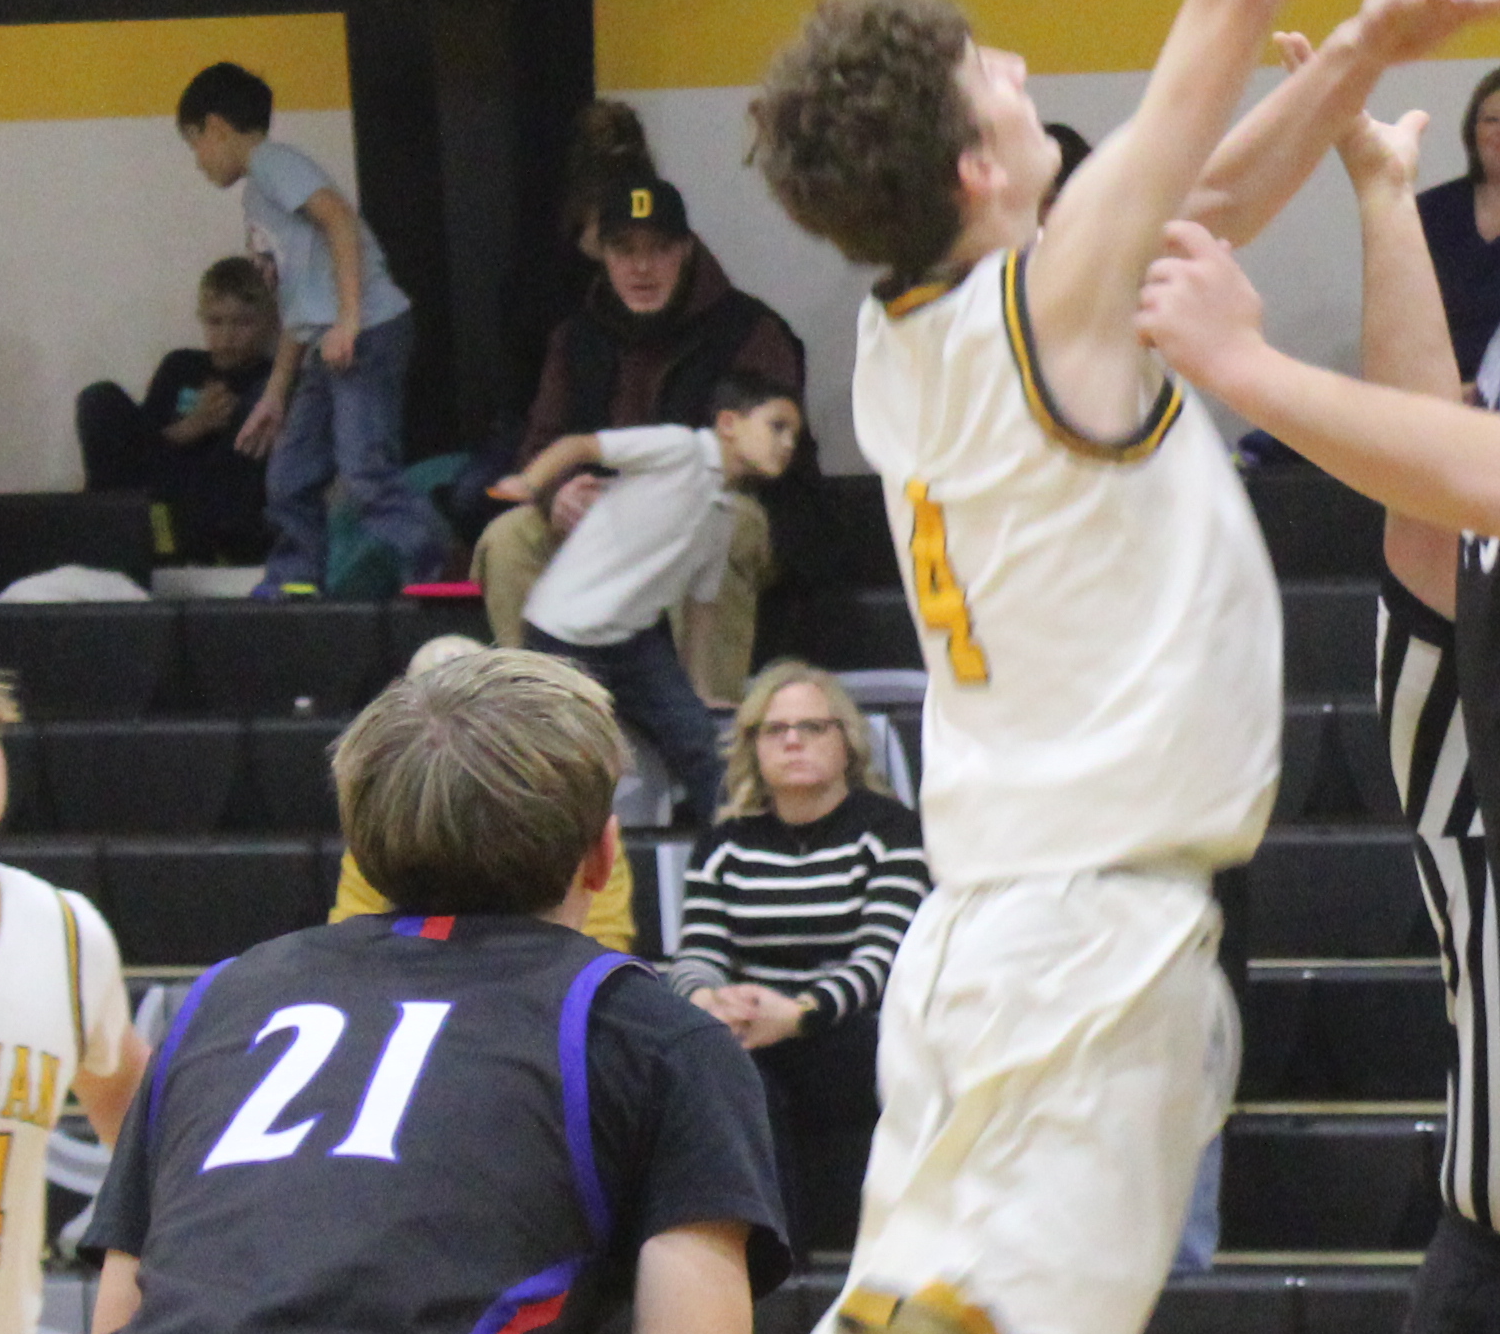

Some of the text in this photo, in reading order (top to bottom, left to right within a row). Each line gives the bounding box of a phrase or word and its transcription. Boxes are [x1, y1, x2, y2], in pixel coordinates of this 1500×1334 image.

[630, 189, 653, 218] D
[905, 479, 990, 685] 4
[199, 999, 455, 1173] 21
